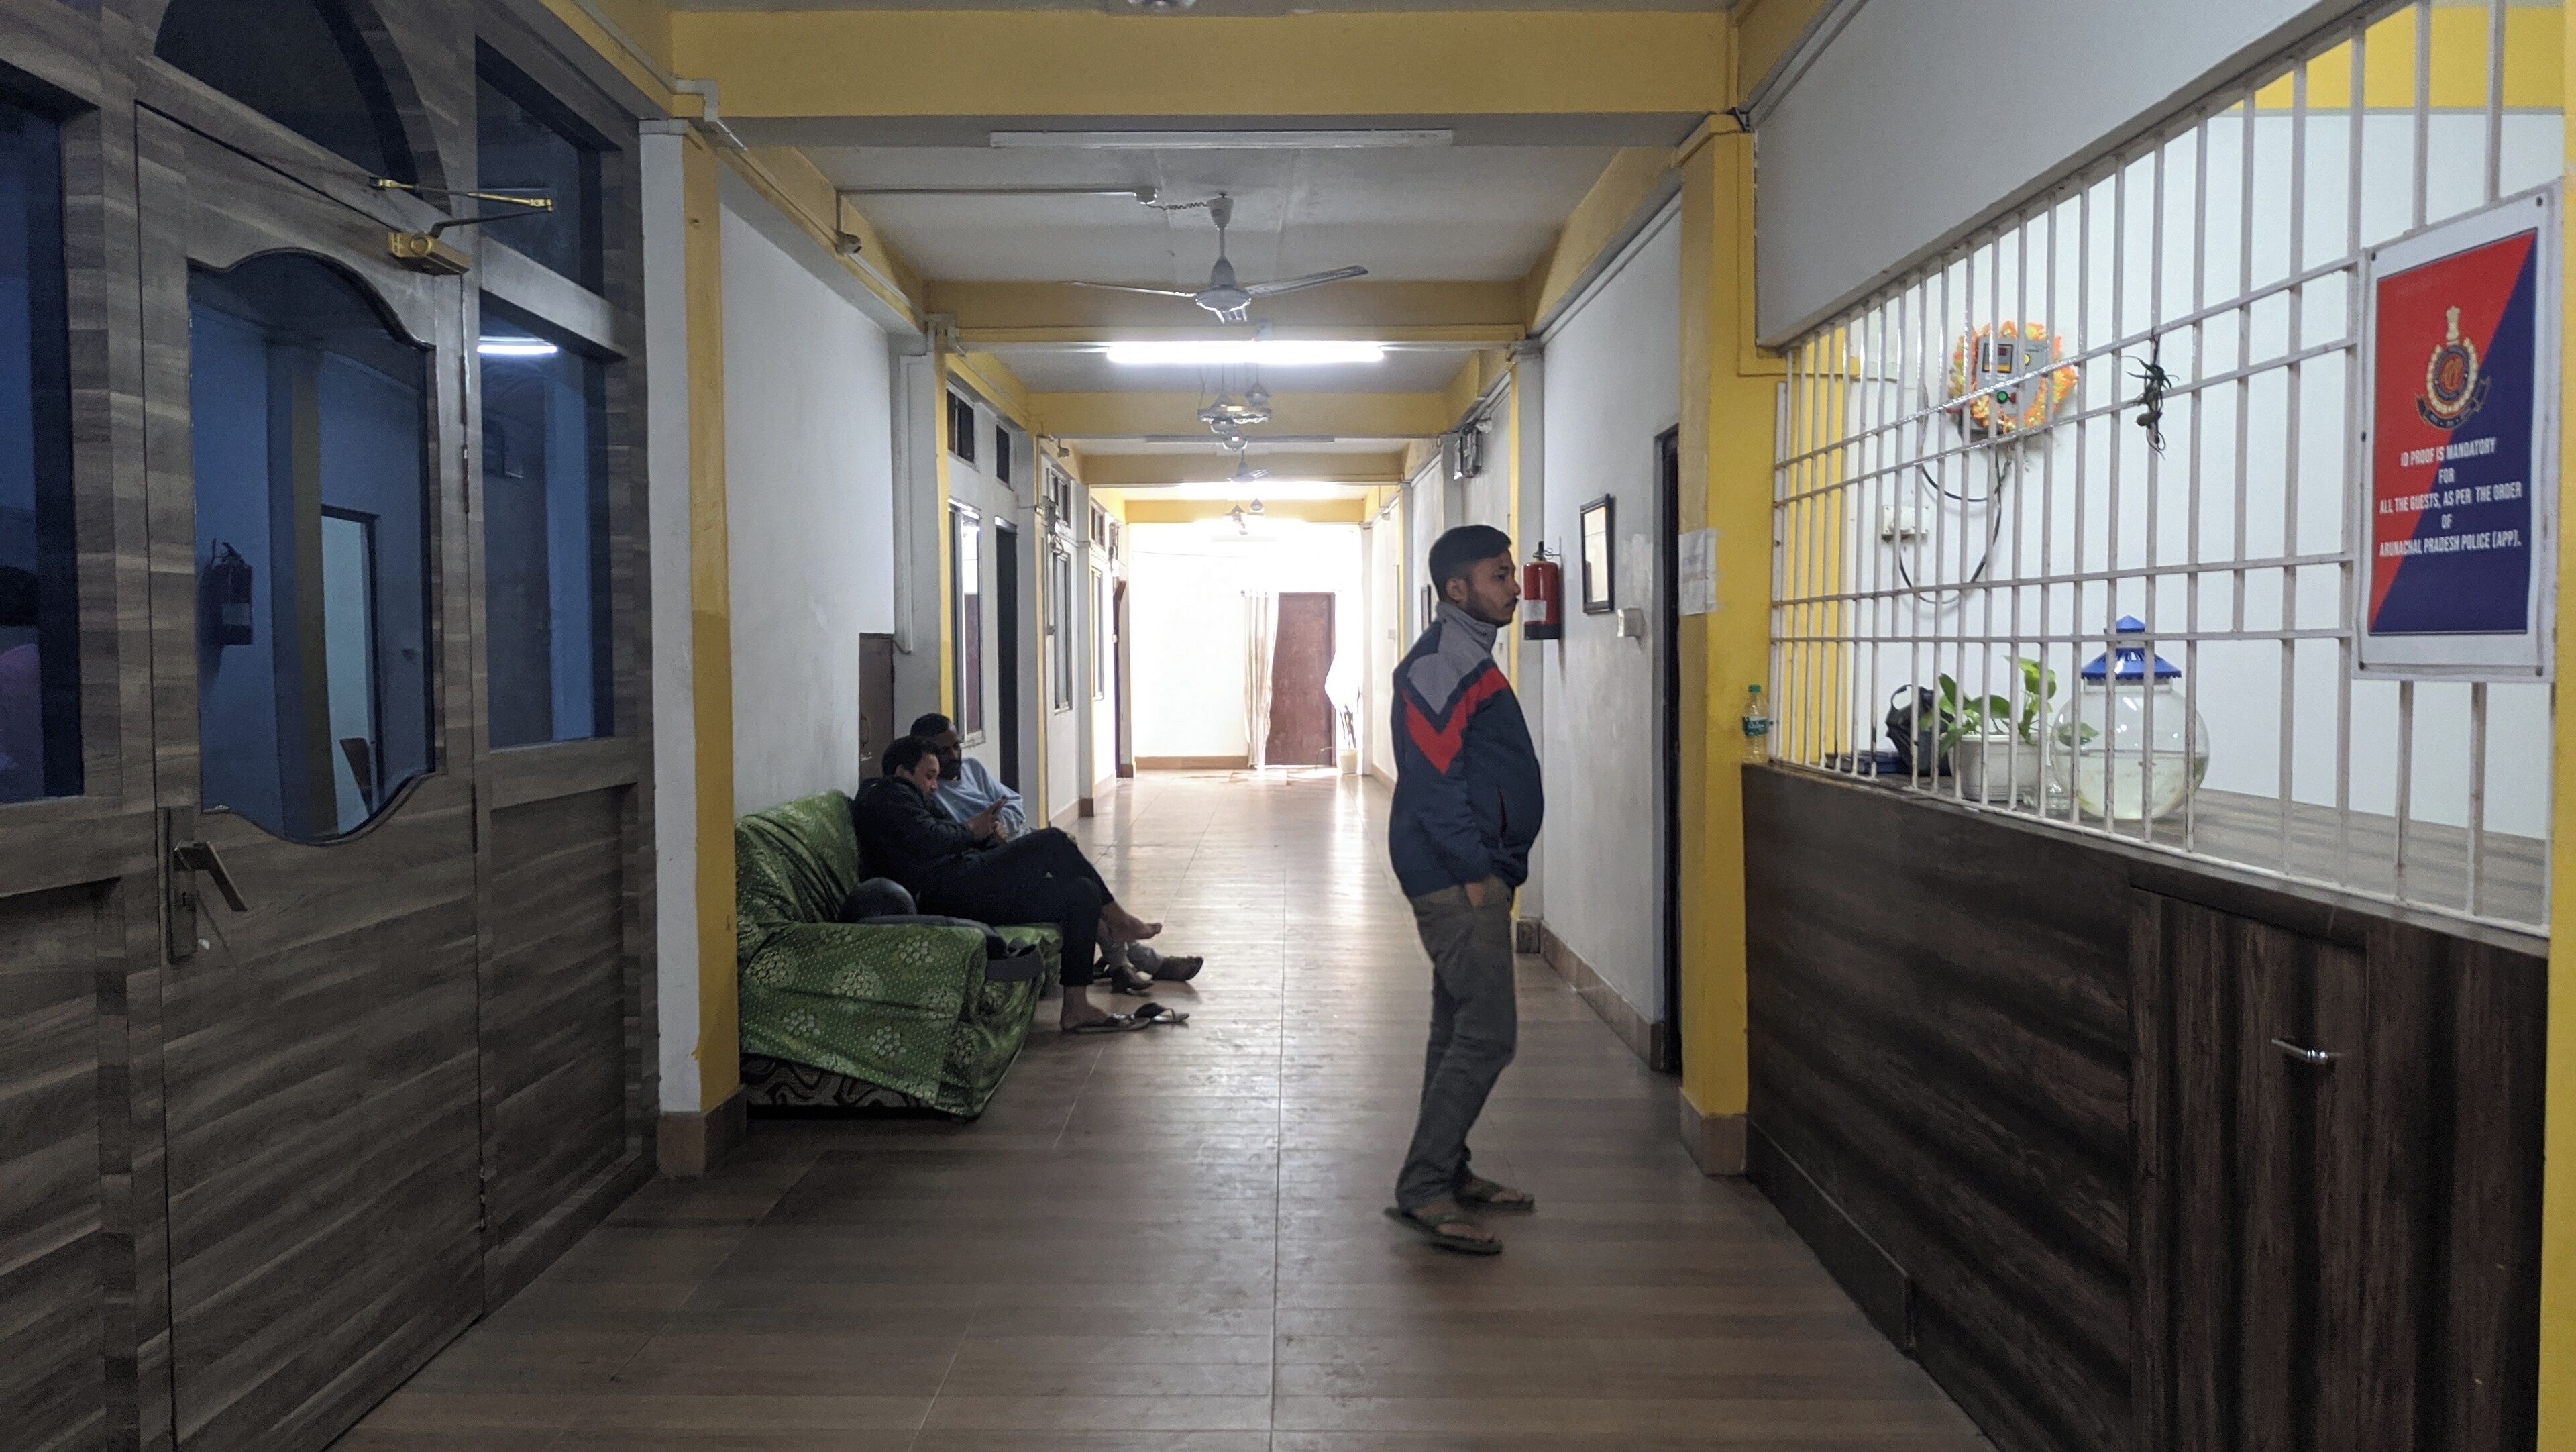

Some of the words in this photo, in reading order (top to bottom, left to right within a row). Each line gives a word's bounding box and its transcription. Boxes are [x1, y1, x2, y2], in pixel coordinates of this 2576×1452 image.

[2400, 452, 2408, 467] ID
[2410, 448, 2436, 466] PROOF
[2436, 446, 2445, 462] IS
[2446, 437, 2496, 460] MANDATORY
[2438, 468, 2455, 484] FOR
[2379, 499, 2393, 514] ALL
[2394, 497, 2408, 513] THE
[2410, 492, 2441, 510] GUESTS,
[2443, 490, 2454, 507] AS
[2455, 488, 2472, 505] PER
[2475, 485, 2492, 503] THE
[2493, 481, 2522, 501] ORDER
[2441, 513, 2452, 529] OF
[2379, 539, 2423, 557] ARUNACHAL
[2424, 535, 2459, 553] PRADESH
[2461, 532, 2491, 550] POLICE
[2492, 529, 2522, 549] (APP).
